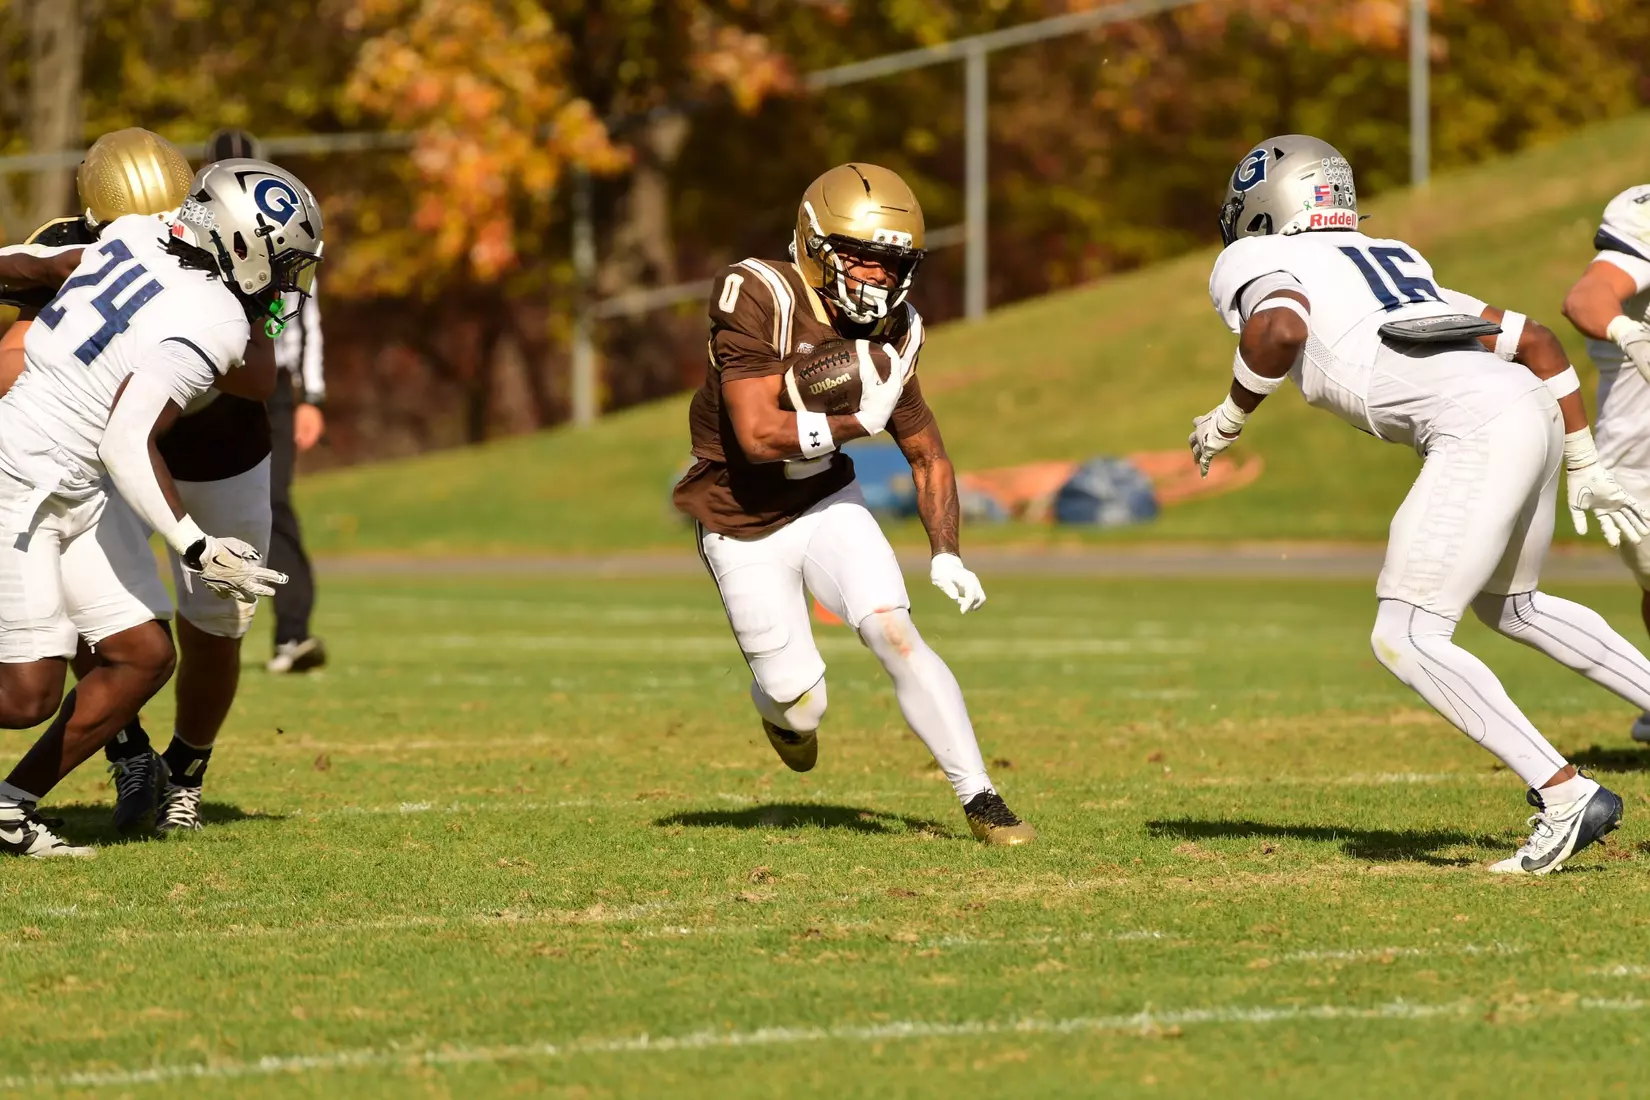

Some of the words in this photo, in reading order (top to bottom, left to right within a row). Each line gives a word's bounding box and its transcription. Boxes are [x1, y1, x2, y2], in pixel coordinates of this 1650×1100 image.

[1232, 148, 1270, 193] G
[254, 178, 301, 226] G
[1310, 212, 1357, 227] Riddell
[718, 272, 744, 314] 0
[1337, 246, 1448, 313] 16
[37, 239, 165, 367] 24
[809, 372, 852, 395] Wilson
